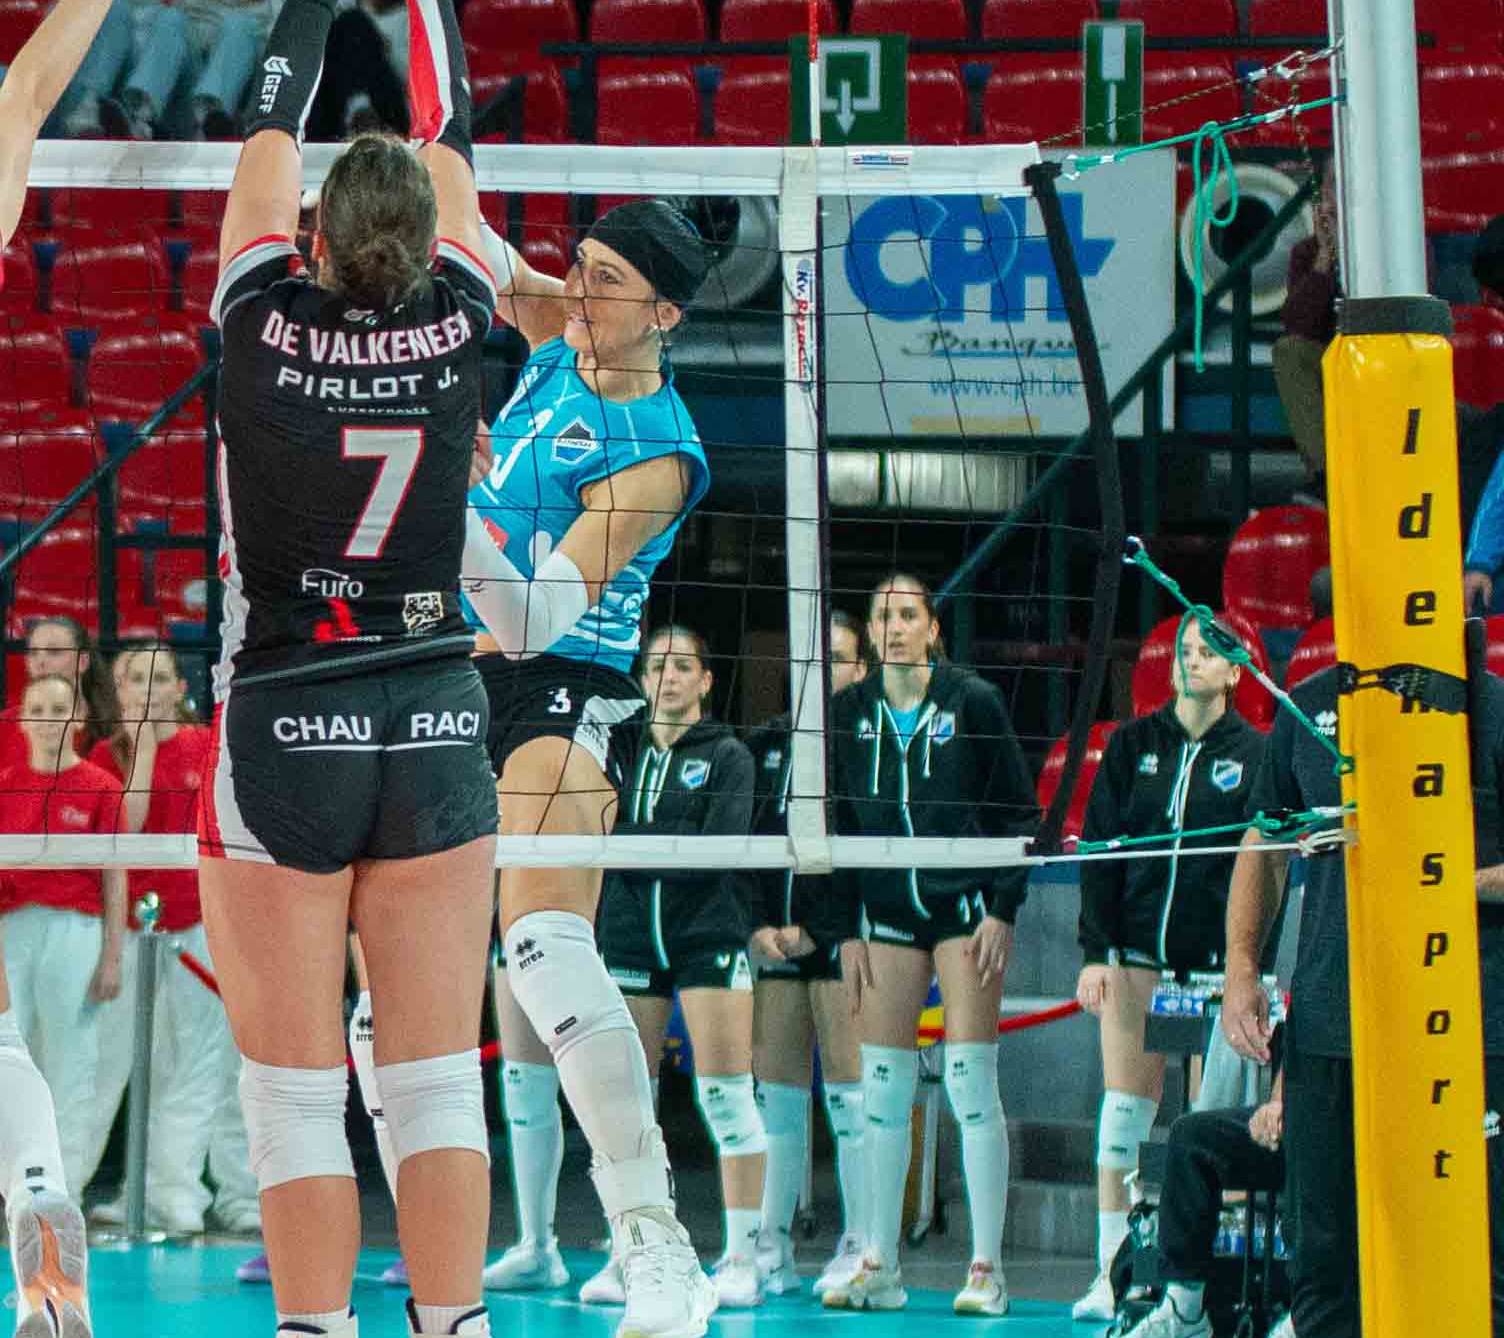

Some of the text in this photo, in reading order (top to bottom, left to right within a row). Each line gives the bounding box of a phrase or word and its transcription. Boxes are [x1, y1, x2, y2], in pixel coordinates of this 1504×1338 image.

[260, 308, 303, 357] DE
[901, 329, 1084, 359] Banqu
[276, 365, 459, 400] PIRLOT J.
[340, 424, 426, 562] 7
[547, 687, 572, 714] 3
[273, 710, 480, 743] CHAU RACI
[1398, 407, 1452, 1180] Ideasport
